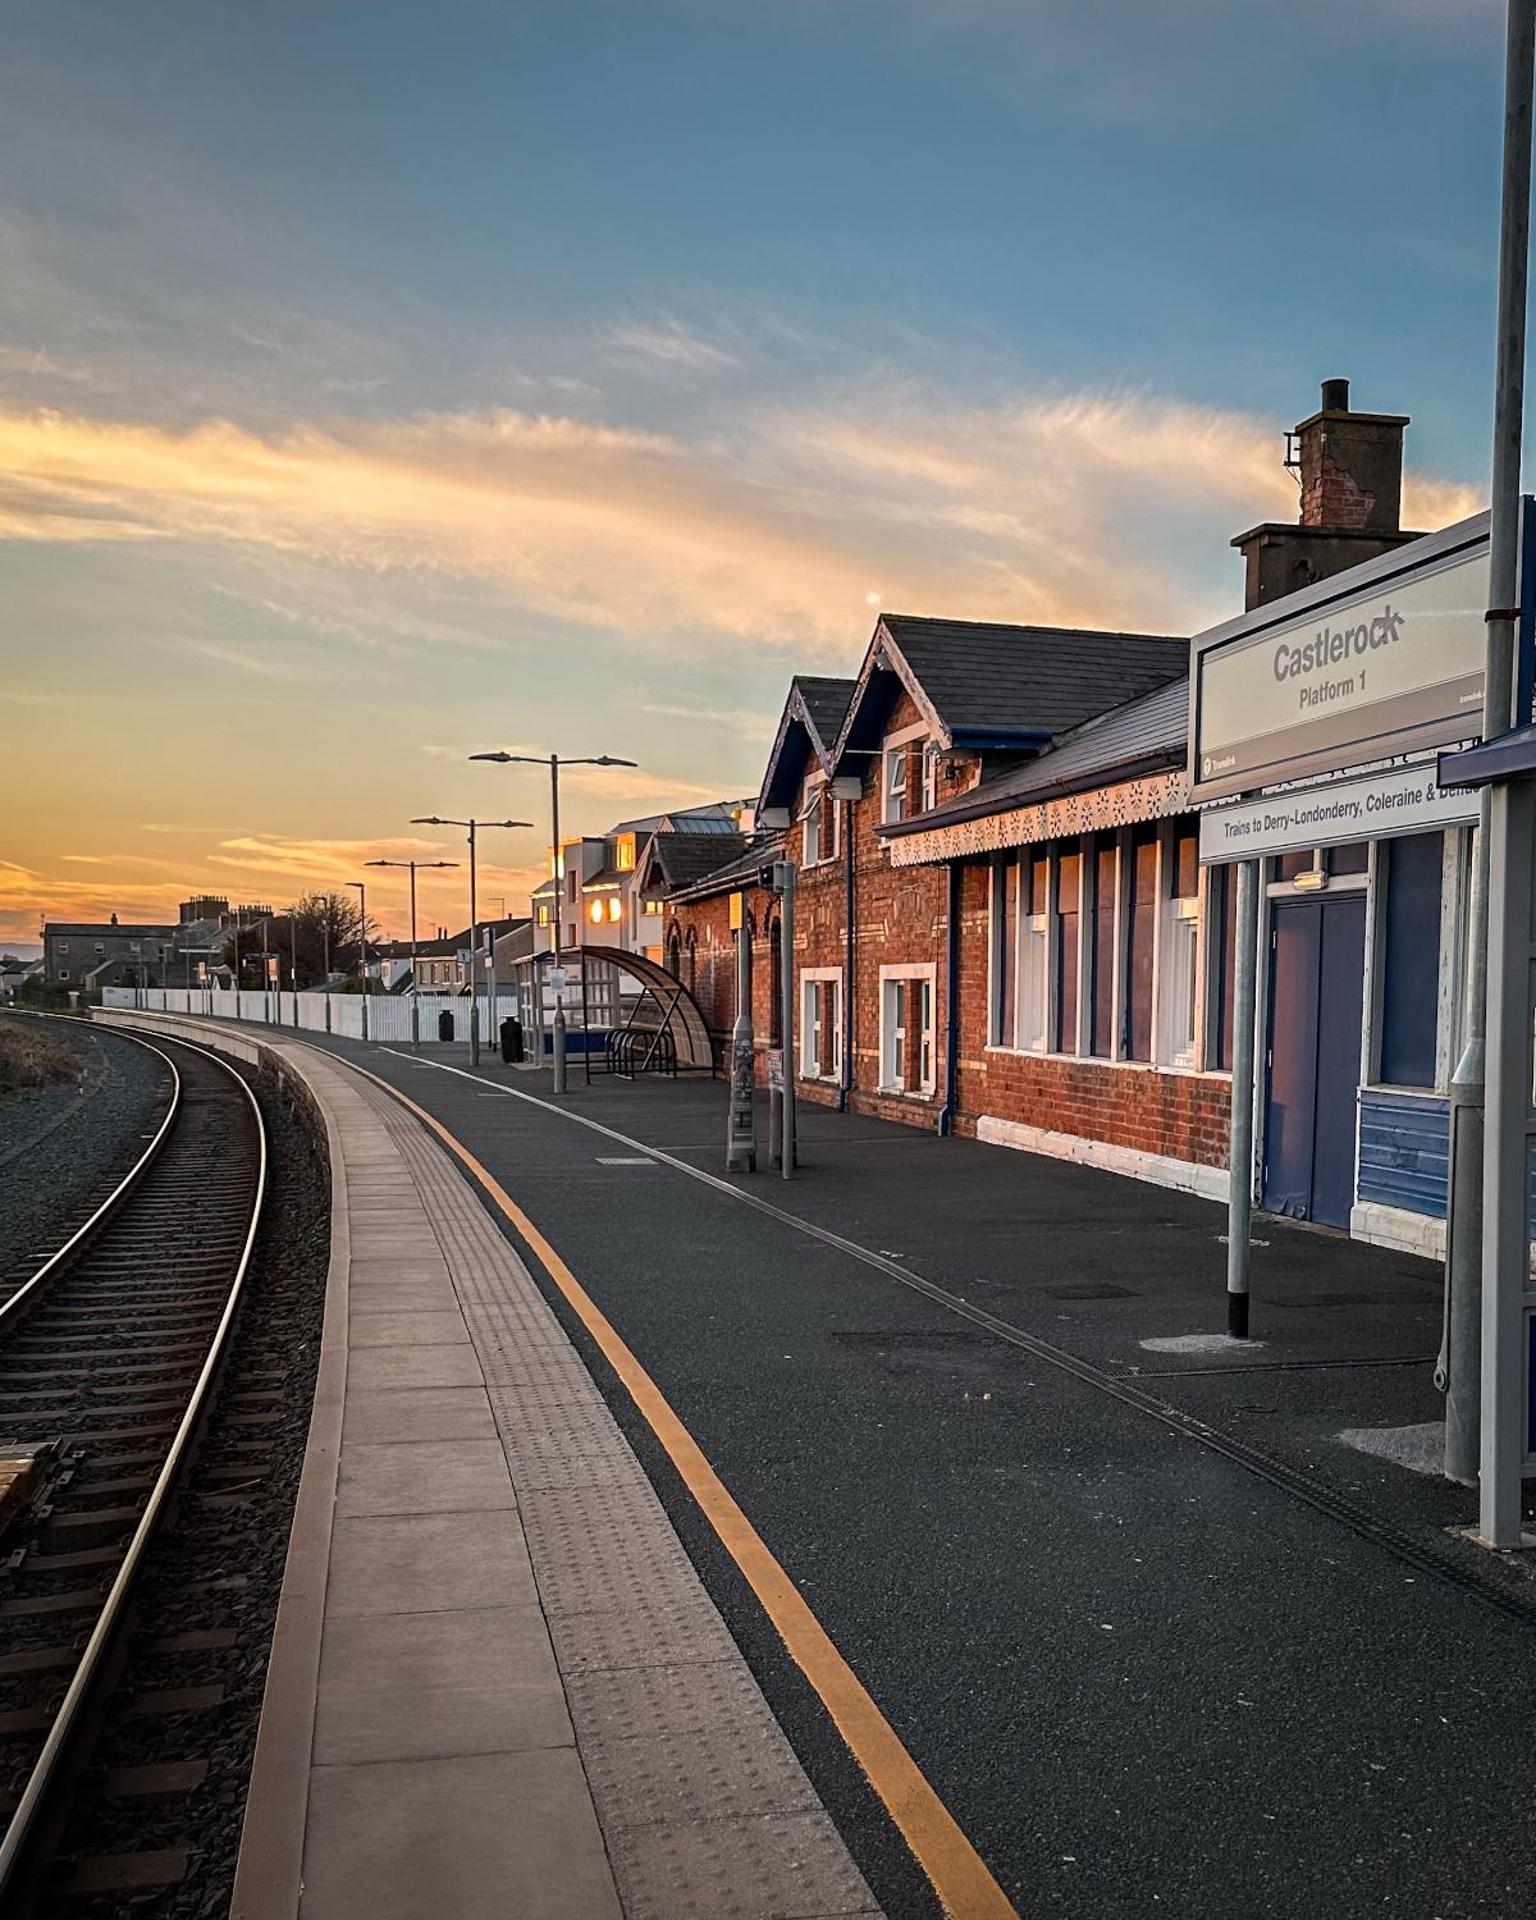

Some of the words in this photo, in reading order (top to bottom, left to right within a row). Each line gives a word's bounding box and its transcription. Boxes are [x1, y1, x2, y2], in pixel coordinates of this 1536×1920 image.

[1274, 604, 1405, 682] Castlerock
[1299, 678, 1354, 709] Platform
[1359, 669, 1366, 690] 1
[1224, 823, 1250, 838] Trains
[1253, 818, 1262, 832] to
[1366, 788, 1423, 812] Coleraine
[1426, 783, 1436, 802] &
